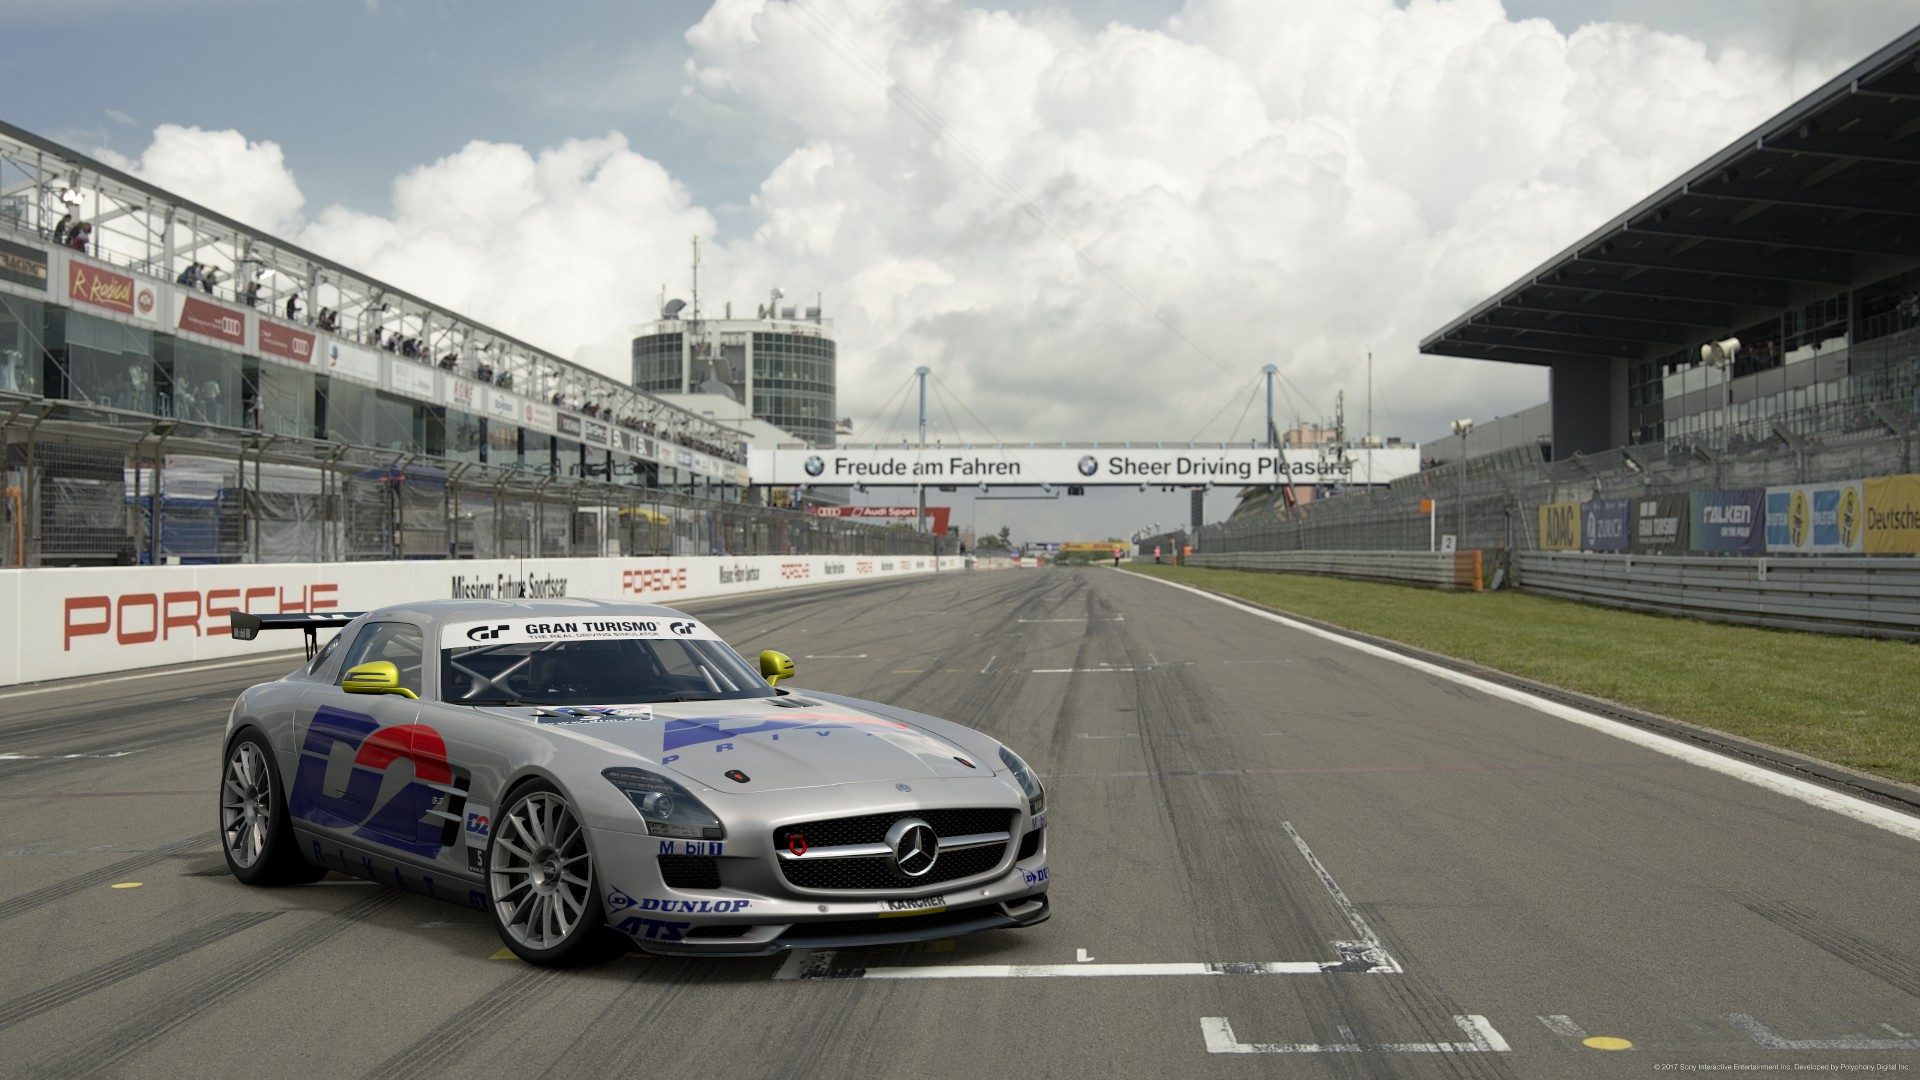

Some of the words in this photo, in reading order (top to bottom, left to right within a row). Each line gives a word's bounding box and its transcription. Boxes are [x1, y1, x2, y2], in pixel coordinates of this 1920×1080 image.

[835, 457, 907, 475] Freude
[912, 463, 943, 475] am
[950, 457, 1020, 475] Fahren
[1109, 456, 1171, 475] Sheer
[1177, 456, 1251, 479] Driving
[864, 507, 886, 516] Audi
[888, 507, 916, 517] Sport
[1703, 505, 1751, 523] FALKEN
[1546, 505, 1574, 547] ADAC
[1445, 536, 1453, 549] 2
[623, 568, 687, 594] PORSCHE
[525, 623, 578, 634] GRAN
[583, 621, 657, 632] TURISMO
[659, 840, 705, 855] Mobil
[639, 898, 750, 912] DUNLOP
[615, 916, 691, 941] ATS
